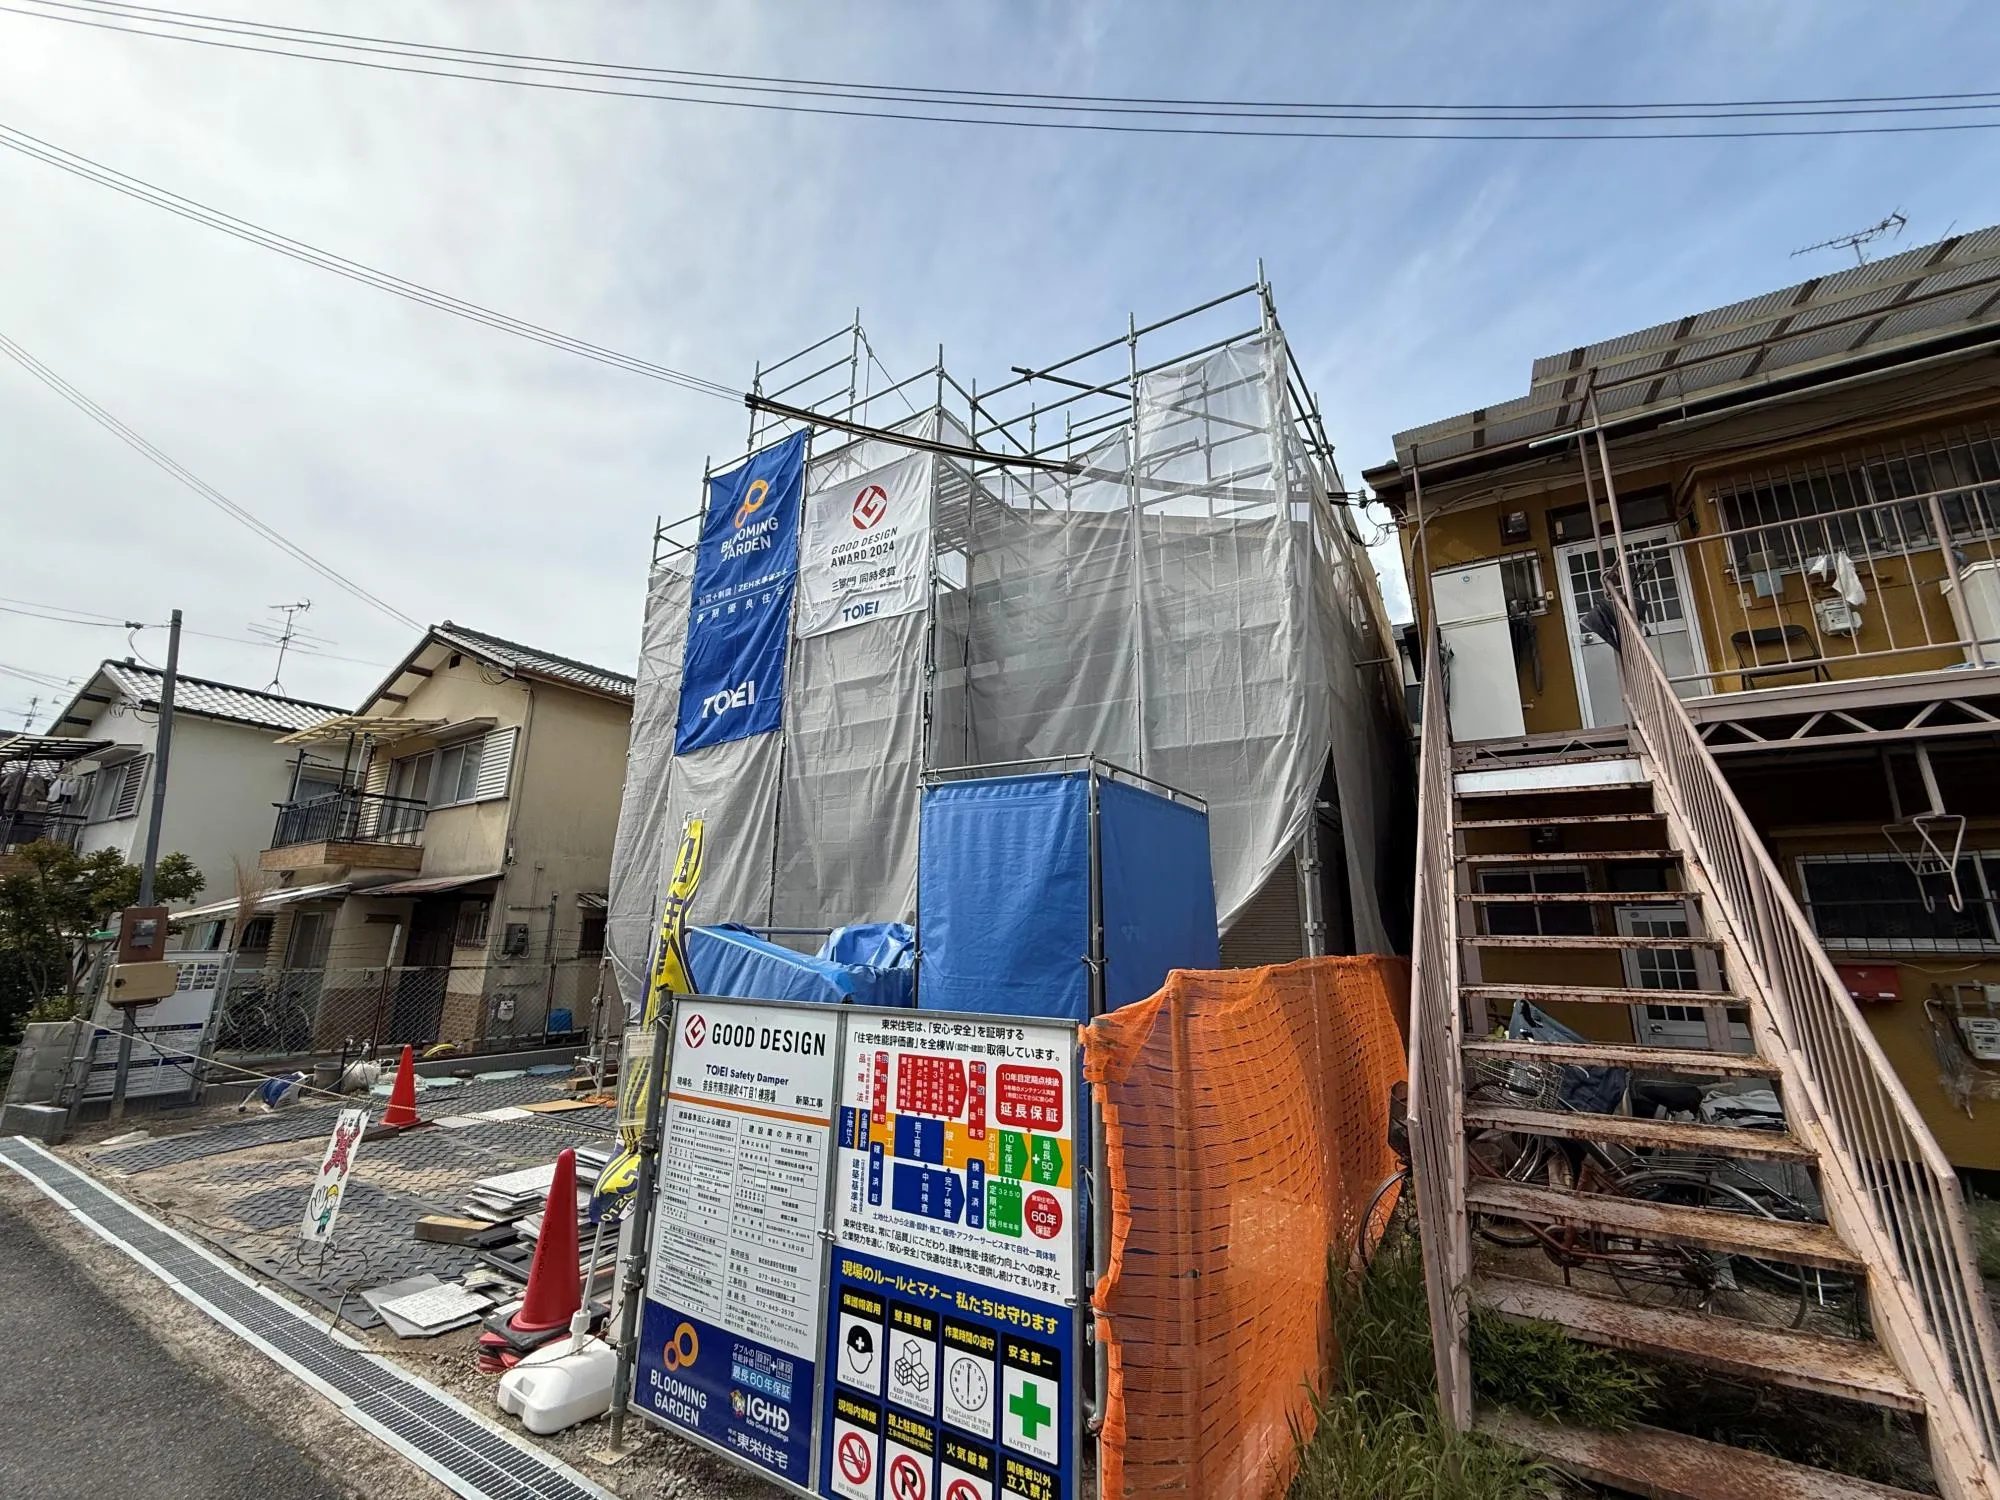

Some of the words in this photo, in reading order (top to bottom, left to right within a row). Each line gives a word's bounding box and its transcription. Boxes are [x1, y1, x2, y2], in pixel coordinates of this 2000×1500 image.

[830, 551, 867, 568] AWARD
[870, 540, 895, 557] 2024
[831, 540, 859, 555] GOOD
[861, 526, 898, 547] DESIGN
[860, 566, 897, 585] 同時受賞
[842, 600, 880, 622] TOEI
[701, 680, 755, 719] TOEI
[712, 1022, 755, 1048] GOOD
[760, 1028, 826, 1056] DESIGN
[706, 1064, 728, 1077] TOEI
[730, 1069, 755, 1083] Safety
[757, 1072, 789, 1086] Damper
[795, 1095, 824, 1108] 新築工事
[1000, 1101, 1059, 1123] 延長保証
[845, 1110, 854, 1145] 土地仕入
[1004, 1133, 1015, 1174] 10年保証
[943, 1176, 953, 1219] 完了検査
[970, 1162, 980, 1225] 検査済証
[1031, 1210, 1057, 1226] 60年
[1035, 1225, 1051, 1237] 保証
[841, 1259, 952, 1301] 現場のルールとマナー
[955, 1291, 1059, 1335] 私たちは守ります
[1008, 1344, 1053, 1366] 安全第一
[650, 1369, 707, 1410] BLOOMING
[732, 1364, 791, 1399] 最長60年保証
[654, 1391, 699, 1427] GARDEN
[888, 1413, 933, 1442] 路上駐車禁止
[737, 1432, 789, 1469] 東栄住宅
[946, 1443, 988, 1471] 火気厳禁
[1008, 1437, 1031, 1451] SAFETY
[1033, 1445, 1051, 1459] FIRST
[1006, 1459, 1052, 1489] 関係者以外
[1006, 1474, 1052, 1500] 立入禁止
